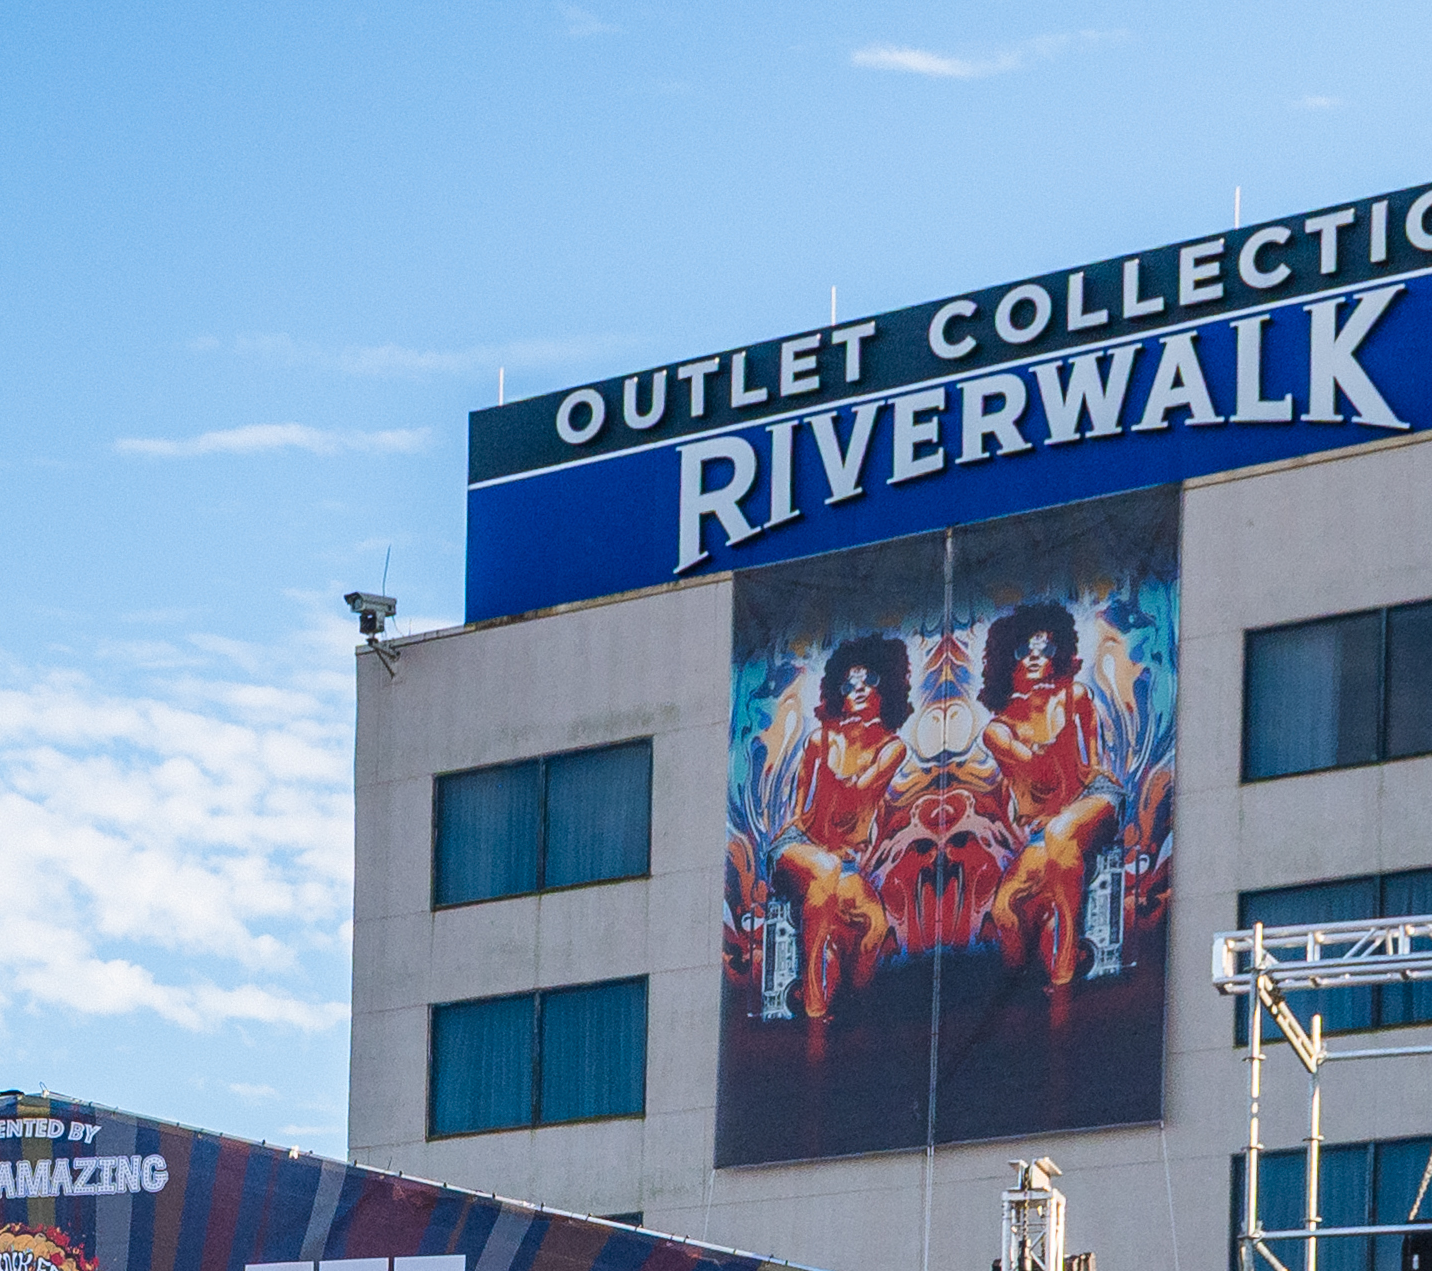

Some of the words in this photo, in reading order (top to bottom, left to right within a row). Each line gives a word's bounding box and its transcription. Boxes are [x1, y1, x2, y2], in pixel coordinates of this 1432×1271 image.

[556, 321, 880, 451] OUTLET
[672, 283, 1411, 576] RIVERWALK
[68, 1121, 102, 1145] BY
